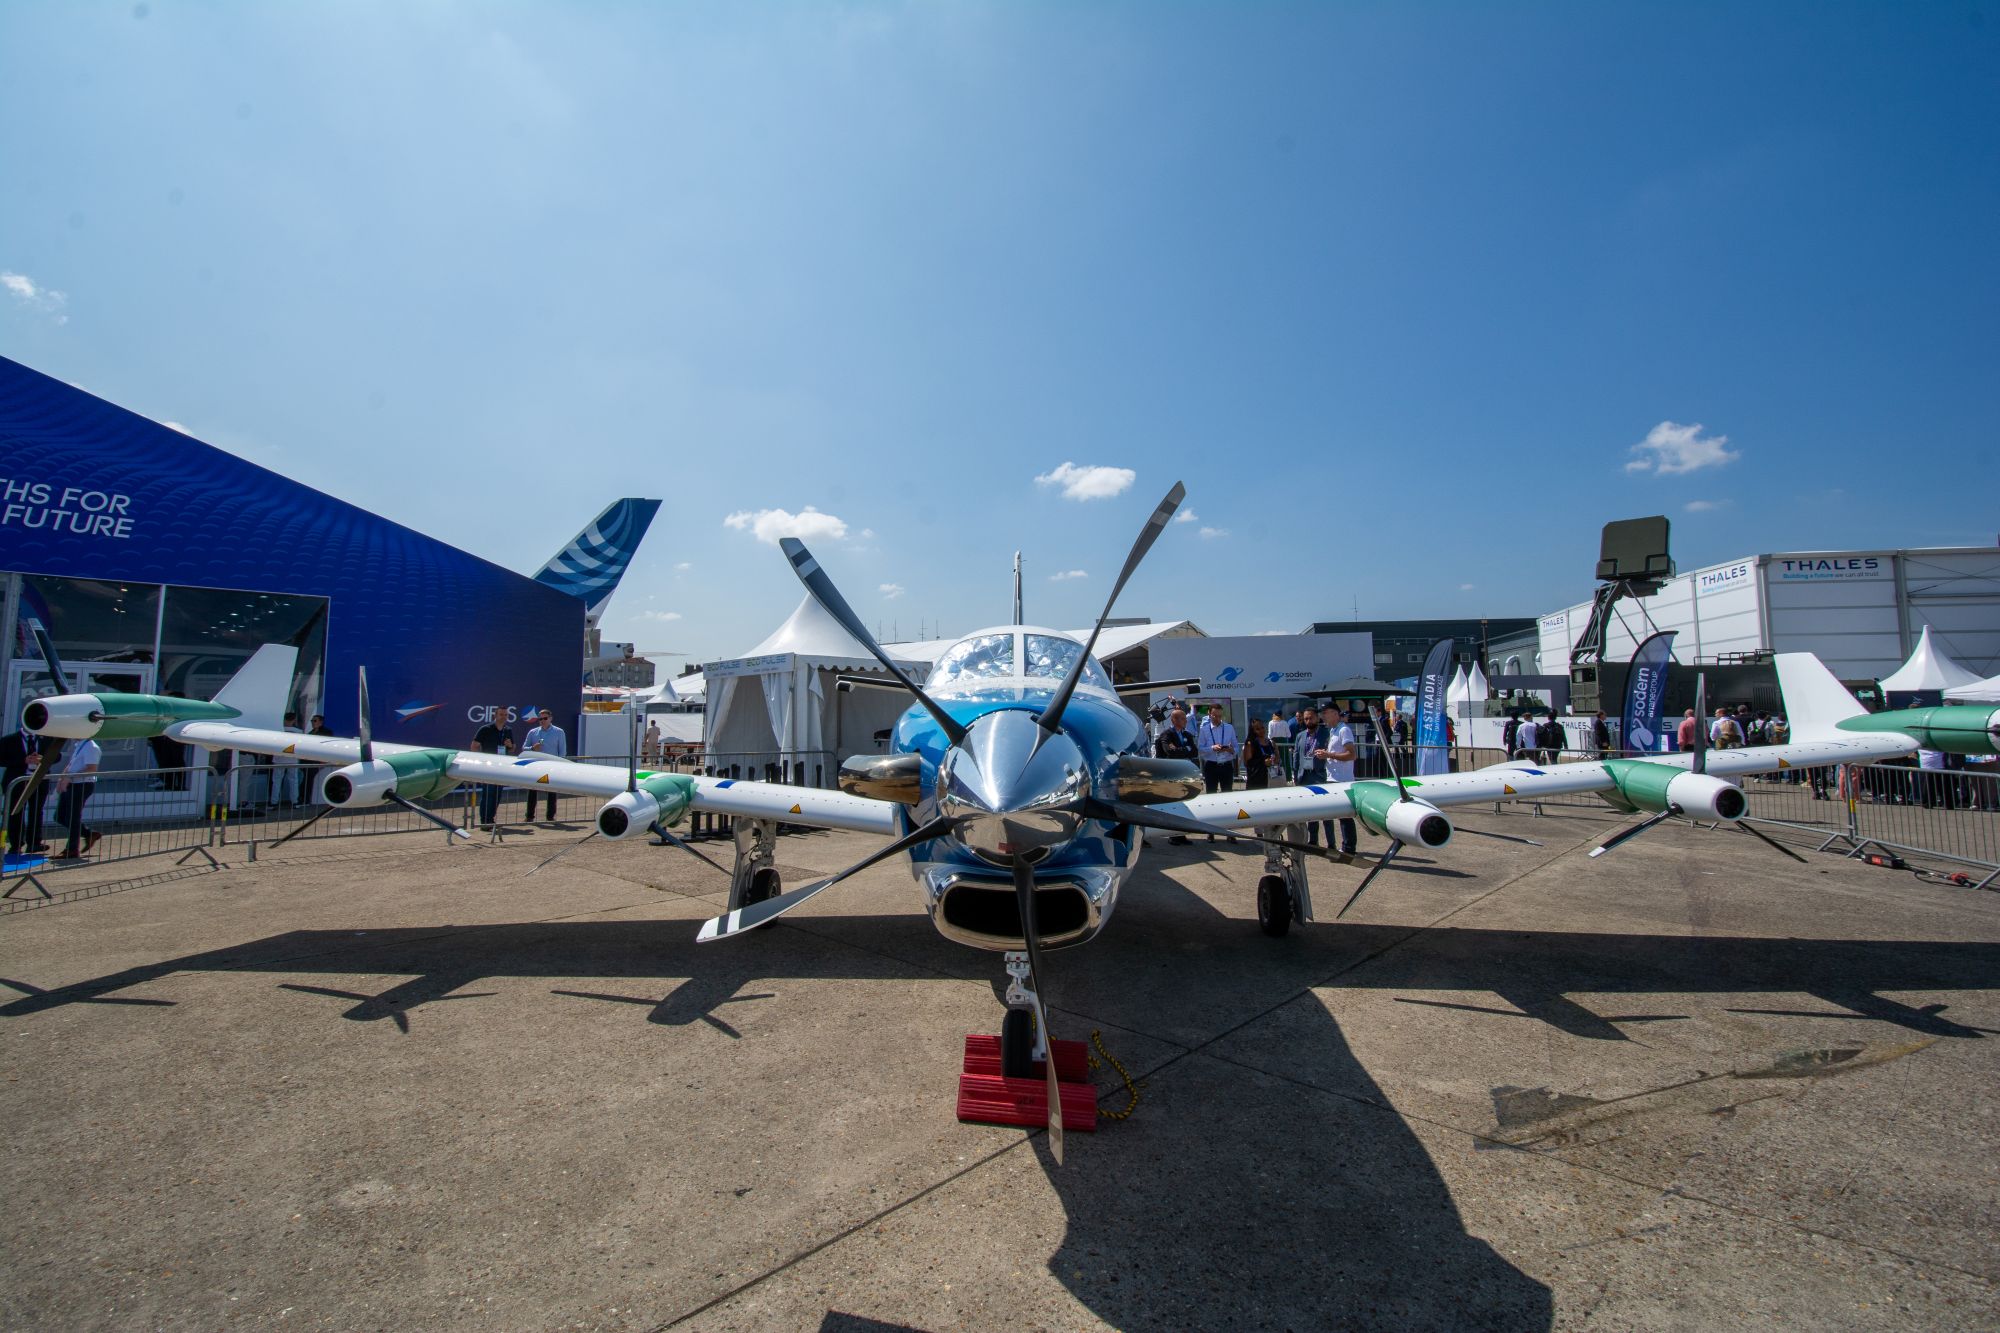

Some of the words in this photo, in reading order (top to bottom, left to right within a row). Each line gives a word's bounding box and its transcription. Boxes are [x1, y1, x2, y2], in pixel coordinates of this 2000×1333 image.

[60, 487, 131, 515] FOR
[1, 504, 135, 538] FUTURE
[1781, 558, 1878, 571] THALES
[1701, 565, 1747, 586] THALES
[1542, 616, 1564, 628] THALES
[1423, 674, 1436, 731] ASTRADIA
[1633, 667, 1650, 717] sodern
[467, 705, 517, 723] GIFS
[1562, 721, 1587, 730] THALES
